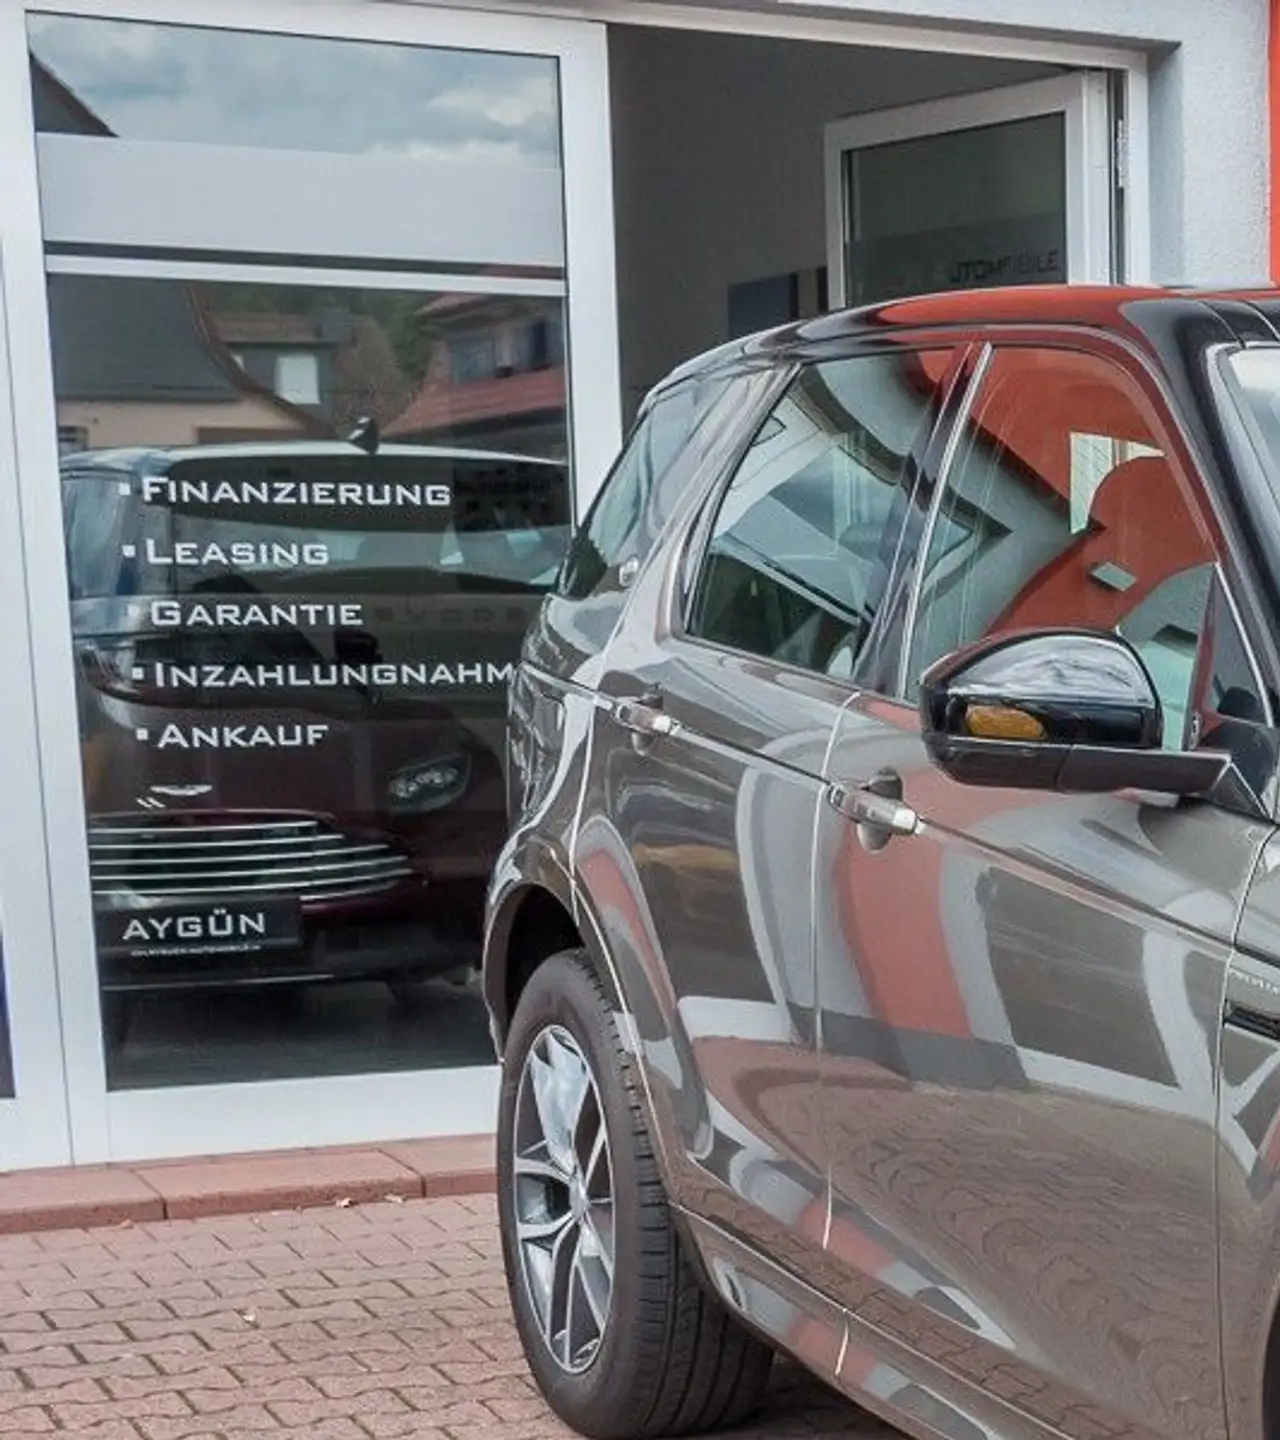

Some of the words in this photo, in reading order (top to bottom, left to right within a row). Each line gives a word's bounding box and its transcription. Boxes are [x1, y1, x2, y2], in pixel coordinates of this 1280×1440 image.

[142, 476, 452, 507] FINANZIERUNG
[146, 538, 330, 566] LEASING
[150, 600, 364, 626] GARANTIE
[155, 661, 514, 688] INZAHLUNGNAHM
[157, 723, 330, 749] ANKAUF
[122, 908, 266, 940] AYGÜN
